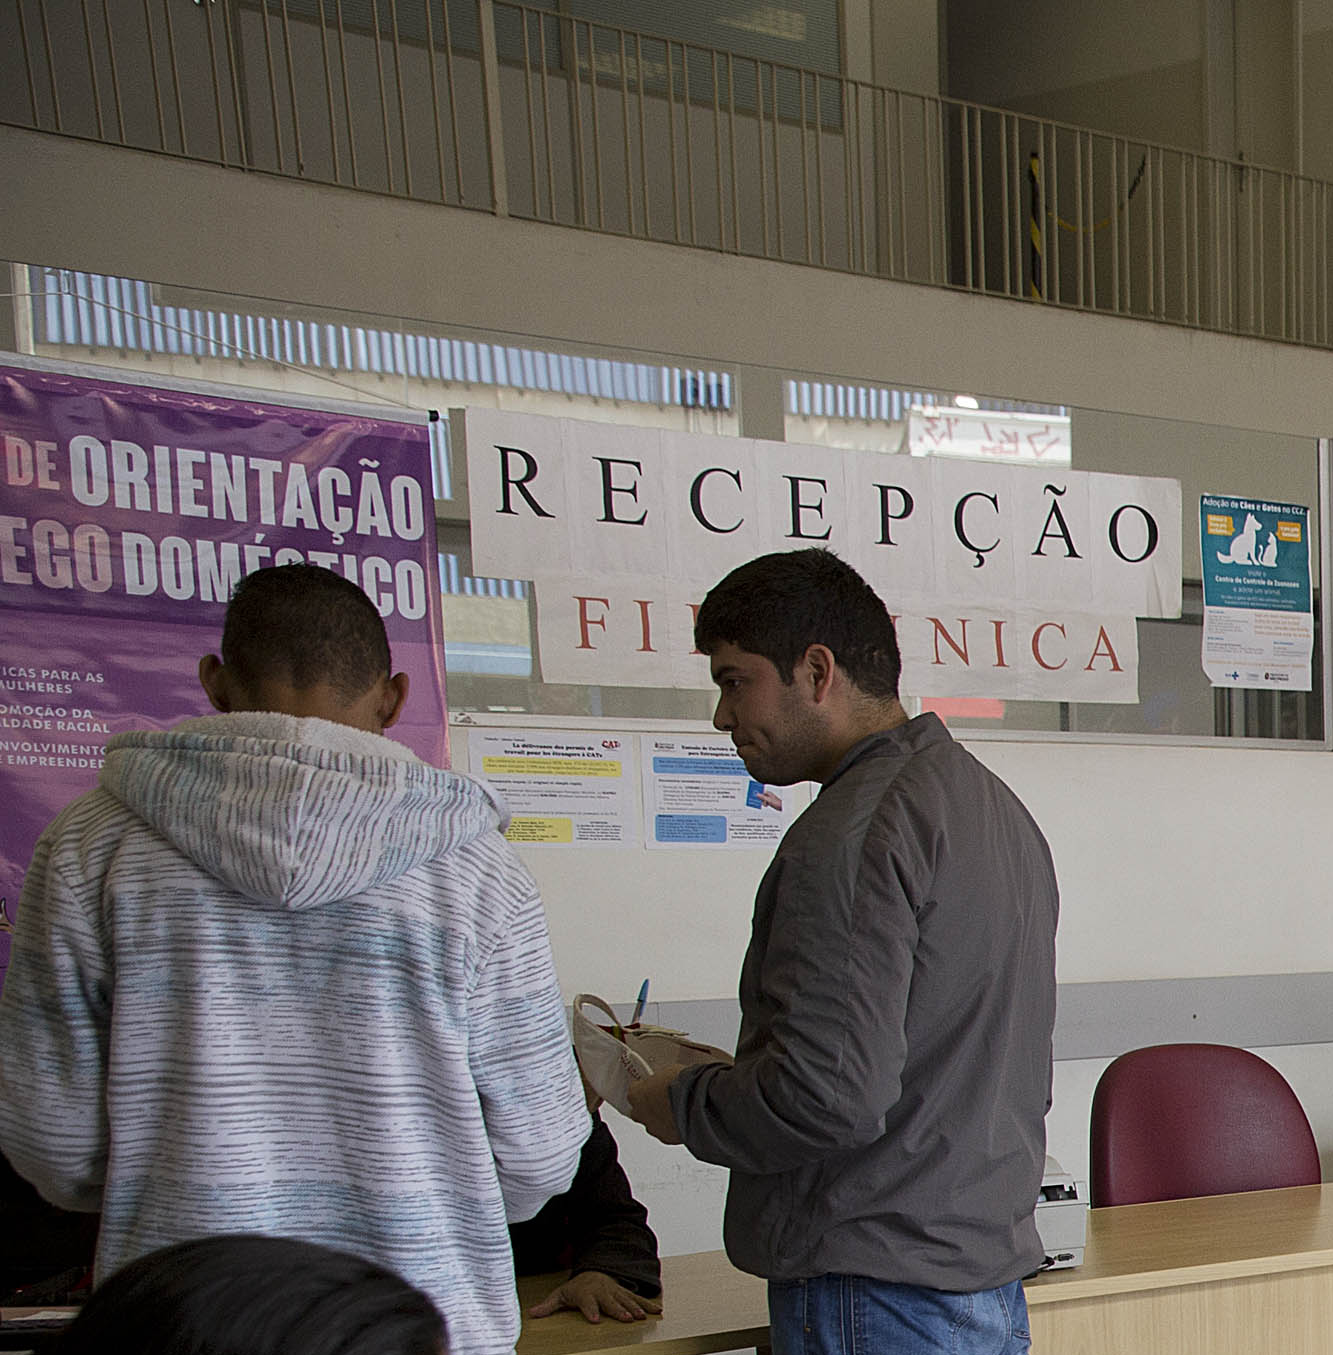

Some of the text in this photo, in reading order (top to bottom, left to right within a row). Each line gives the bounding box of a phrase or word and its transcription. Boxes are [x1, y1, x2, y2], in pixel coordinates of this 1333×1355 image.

[4, 434, 426, 545] DE ORIENTAÇÃO
[493, 444, 1160, 569] RECEPÇÃO
[1203, 497, 1230, 509] Adoção
[1230, 501, 1238, 509] de
[1240, 501, 1255, 510] Cães
[1262, 503, 1281, 512] Gatos
[121, 532, 428, 621] DOMICO
[1215, 575, 1233, 583] Centro
[1234, 576, 1241, 584] de
[890, 614, 1125, 674] NICA
[41, 669, 81, 681] PARA
[85, 673, 104, 683] AS
[72, 709, 93, 719] DA
[0, 718, 111, 733] LDADE RACIAL
